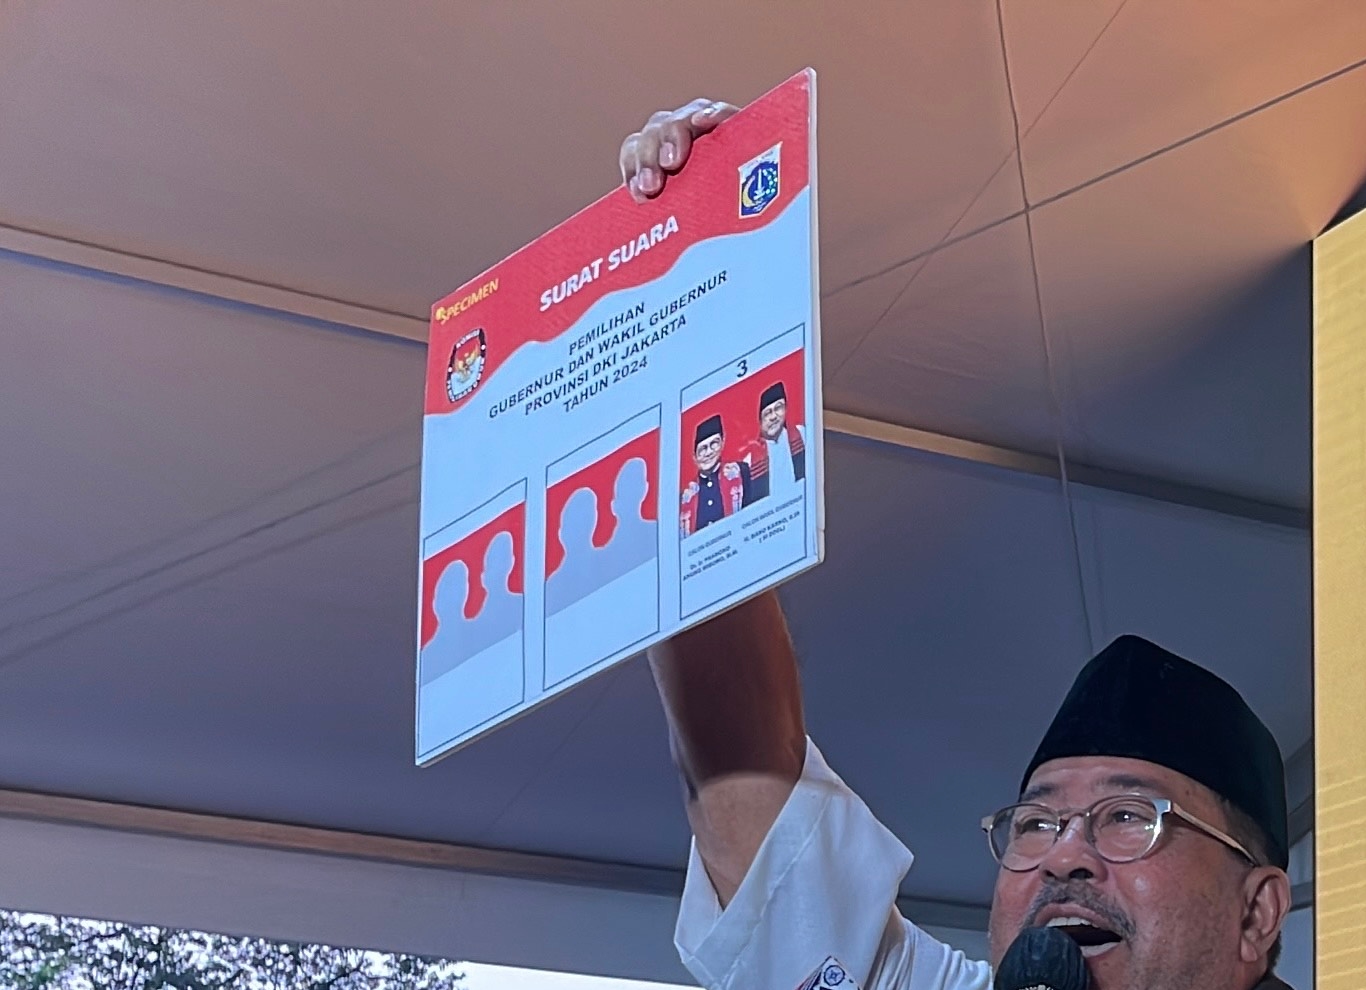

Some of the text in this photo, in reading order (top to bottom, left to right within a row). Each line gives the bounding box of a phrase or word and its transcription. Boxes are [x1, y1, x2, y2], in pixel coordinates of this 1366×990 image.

[540, 215, 679, 312] SURAT SUARA
[438, 278, 499, 325] SPECIMEN
[568, 301, 646, 356] PEMILIHAN
[488, 367, 565, 419] GUBERNUR
[568, 349, 595, 373] DAN
[599, 323, 646, 354] WAKIL
[649, 270, 728, 326] GUBERNUR
[525, 368, 589, 416] PROVINSI
[593, 355, 617, 378] DKI
[621, 314, 687, 360] JAKARTA
[736, 360, 748, 377] 3
[563, 355, 648, 414] TAHUN 2024
